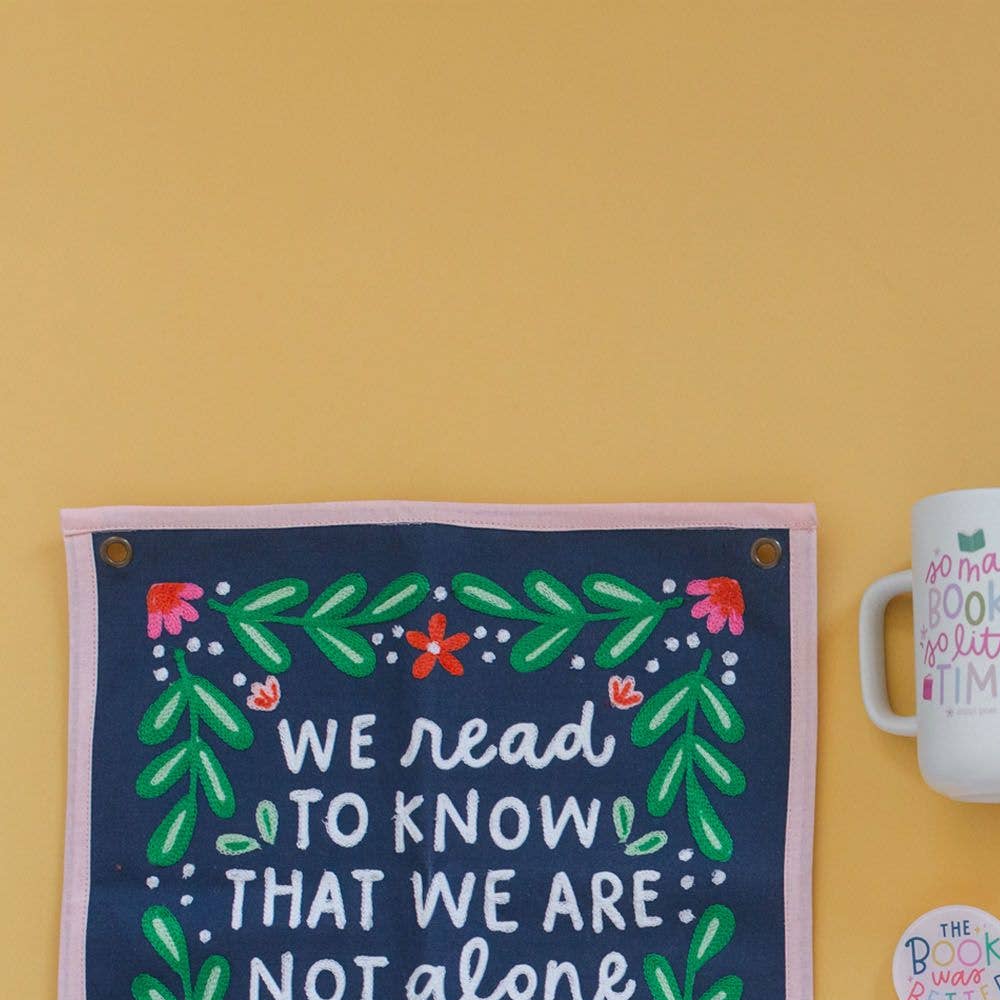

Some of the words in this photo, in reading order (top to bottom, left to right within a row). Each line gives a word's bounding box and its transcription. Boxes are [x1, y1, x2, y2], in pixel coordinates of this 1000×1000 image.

[925, 554, 952, 584] so
[924, 632, 949, 668] so
[279, 714, 377, 773] WE
[400, 700, 615, 769] read
[289, 788, 369, 850] TO
[394, 788, 600, 853] KNOW
[226, 868, 385, 930] THAT
[411, 869, 518, 932] WE
[543, 869, 664, 932] ARE
[940, 920, 971, 938] THE
[931, 967, 985, 986] was
